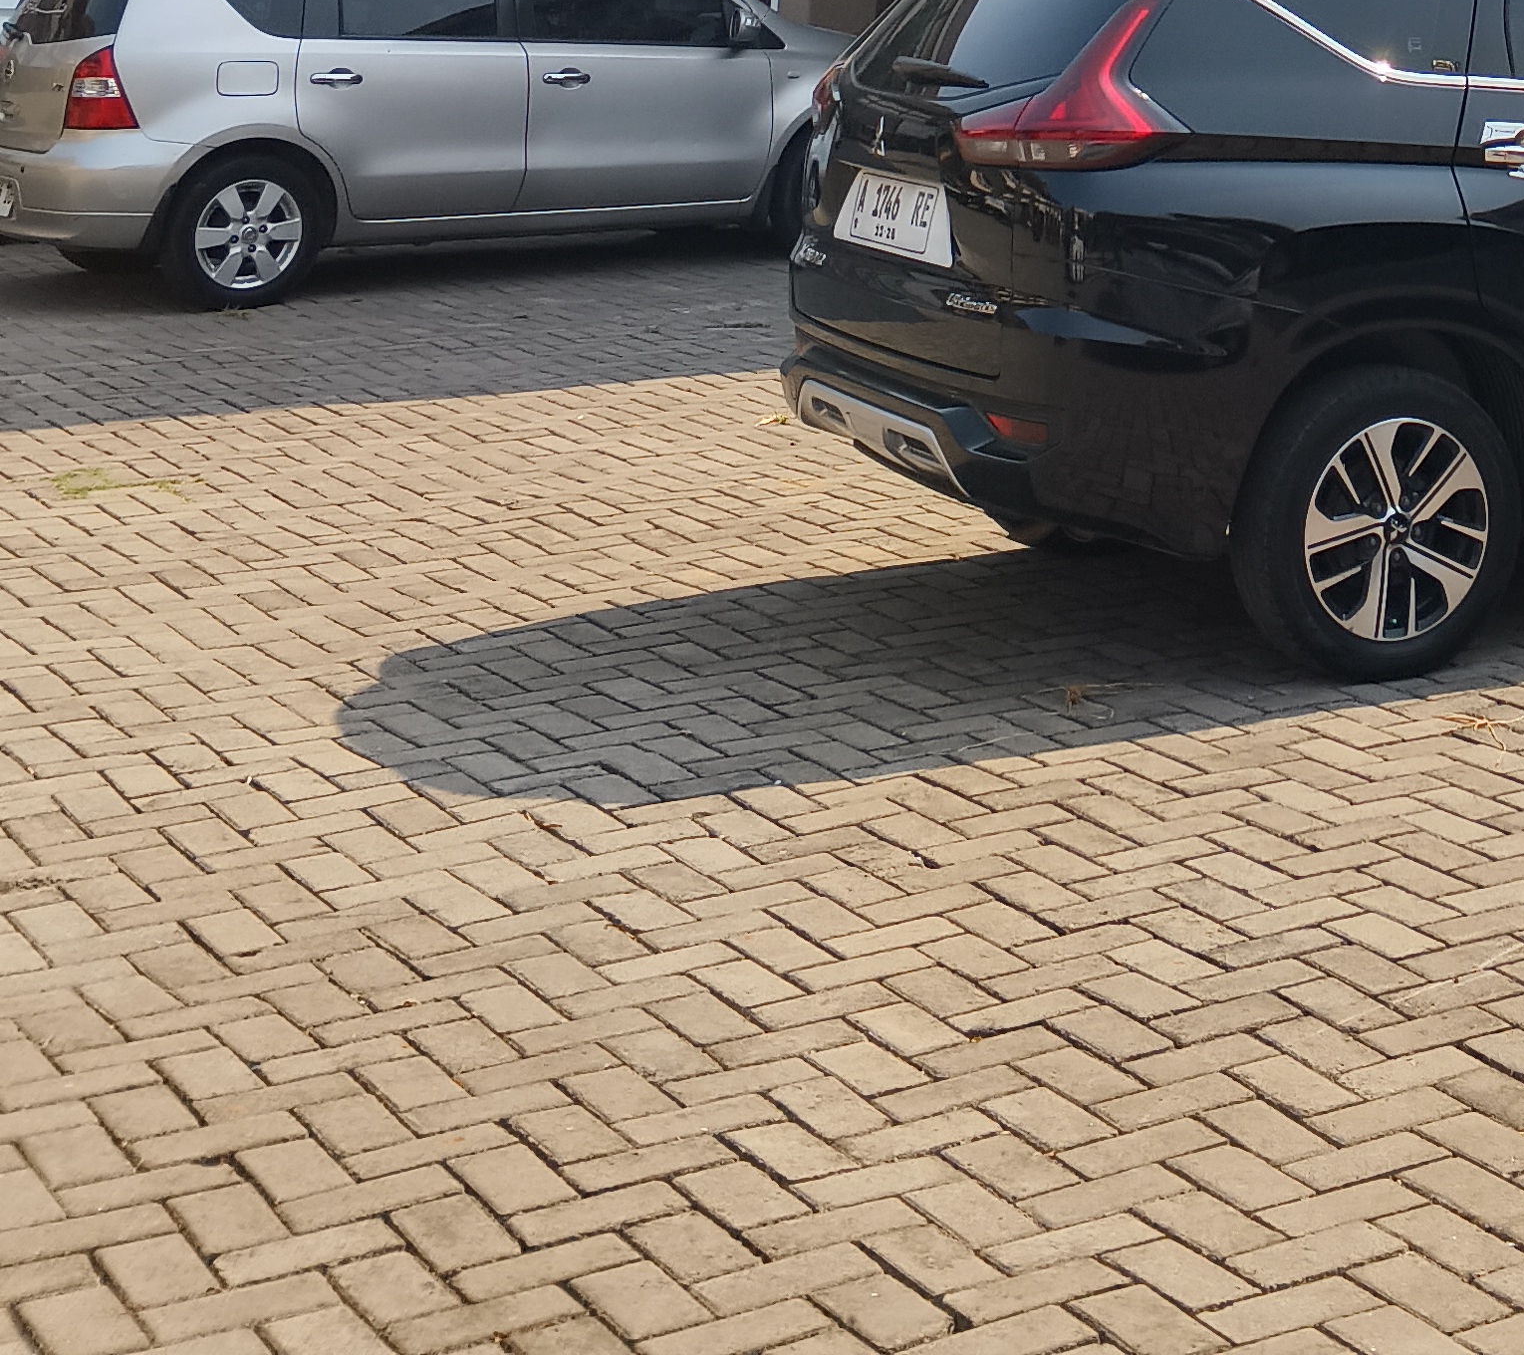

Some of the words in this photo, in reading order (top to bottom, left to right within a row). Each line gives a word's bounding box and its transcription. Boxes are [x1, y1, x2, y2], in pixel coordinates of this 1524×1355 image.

[857, 178, 869, 213] A
[871, 183, 903, 221] 1746
[910, 190, 934, 228] RE
